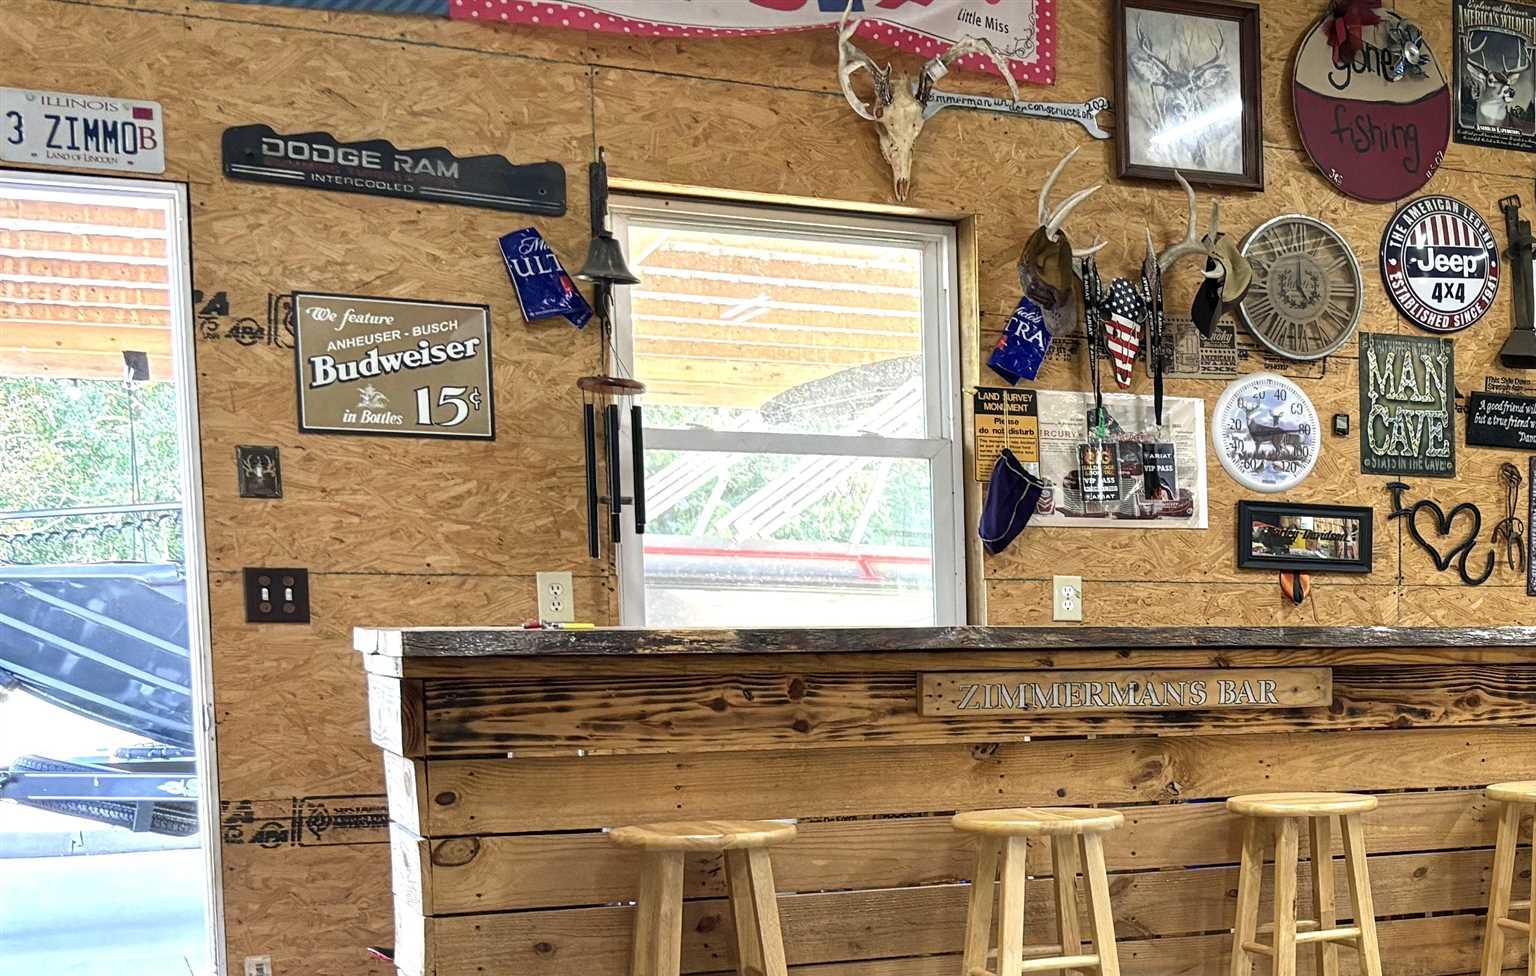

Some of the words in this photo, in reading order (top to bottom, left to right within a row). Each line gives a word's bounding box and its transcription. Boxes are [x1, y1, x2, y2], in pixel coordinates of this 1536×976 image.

[957, 7, 982, 27] Little
[985, 15, 1009, 34] Miss
[1458, 5, 1499, 33] AMERICA'S
[41, 95, 119, 112] ILLINOIS
[921, 94, 992, 107] immerman
[6, 110, 24, 145] 3
[138, 126, 157, 150] B
[1331, 104, 1420, 174] fishing
[262, 137, 382, 169] DODGE
[394, 154, 459, 180] RAM
[311, 172, 415, 194] INTERCOOLED
[1389, 224, 1408, 248] THE
[1402, 199, 1459, 224] AMERICAN
[1463, 207, 1494, 250] LEGEND
[1417, 247, 1478, 278] Jeep
[1389, 271, 1450, 329] ESTABLISHED
[1452, 302, 1483, 326] SINCE
[1482, 276, 1498, 306] 1941
[306, 306, 337, 321] We
[335, 308, 395, 331] feature
[326, 329, 402, 352] ANHEUSER
[412, 319, 459, 337] BUSCH
[310, 337, 481, 388] Budweiser
[1367, 350, 1449, 403] MAN
[978, 391, 1000, 401] LAND
[983, 402, 1029, 412] MONMENT
[1273, 389, 1287, 401] 40
[342, 409, 358, 423] in
[362, 410, 403, 425] Bottles
[993, 417, 1020, 426] Plese
[1299, 423, 1311, 436] 80
[1008, 428, 1035, 436] disturb
[1037, 429, 1078, 438] ERCURY
[1367, 404, 1451, 458] CAVE
[1217, 680, 1278, 704] BAR
